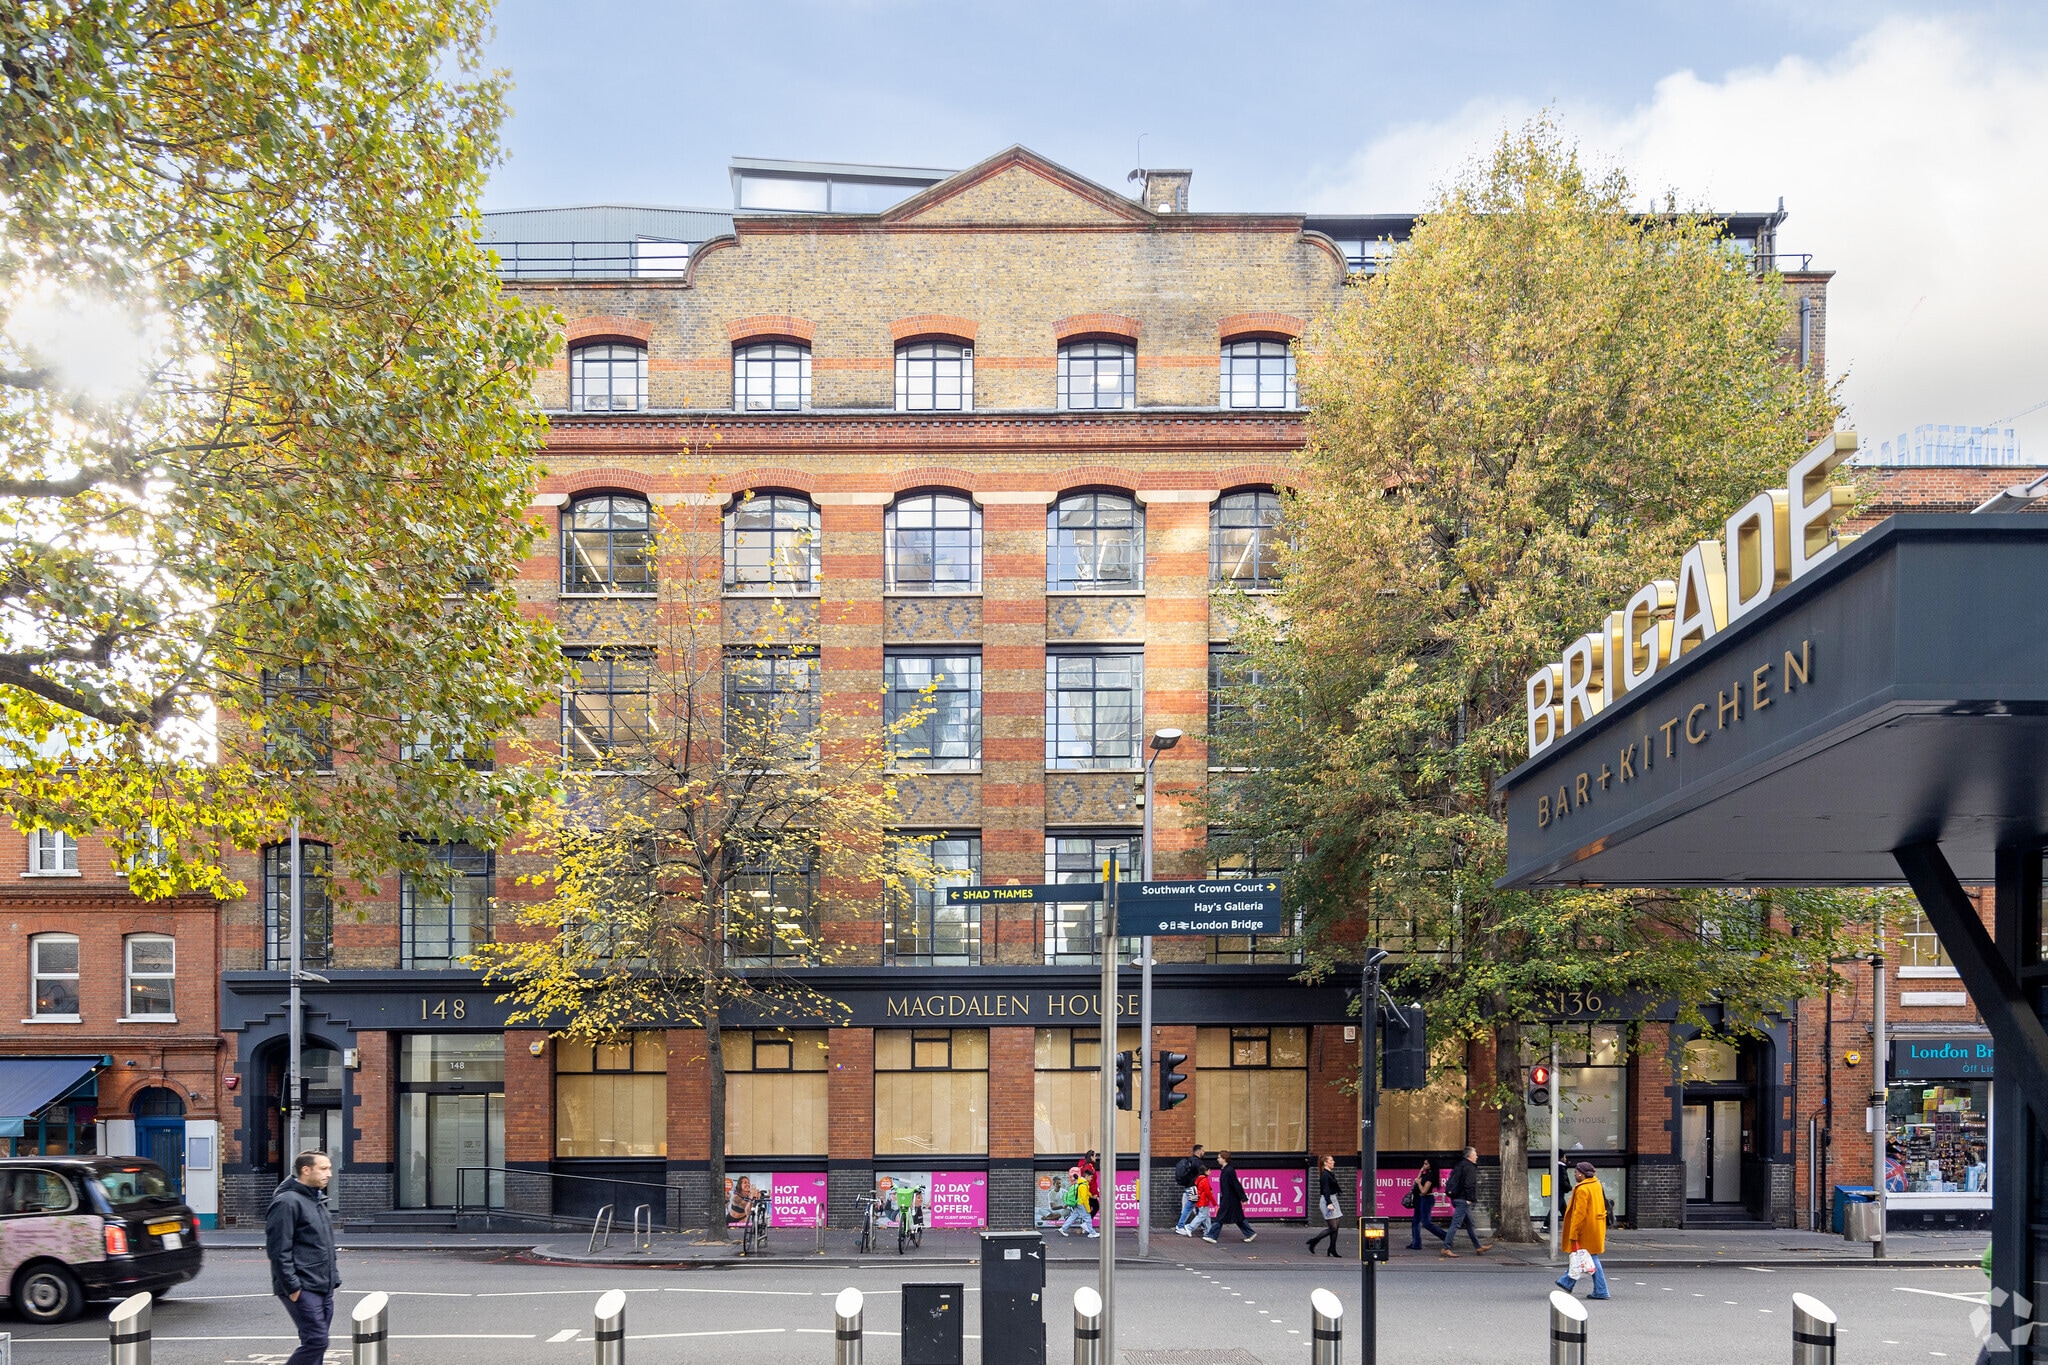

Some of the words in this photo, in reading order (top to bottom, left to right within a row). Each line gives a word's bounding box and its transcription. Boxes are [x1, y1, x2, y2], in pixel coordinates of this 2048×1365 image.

[1526, 432, 1857, 759] BRIGADE
[1142, 884, 1195, 895] Southwark
[1198, 884, 1231, 893] Crown
[1233, 883, 1264, 893] Court
[963, 890, 991, 900] SHAD
[993, 889, 1033, 899] THAMES
[1194, 902, 1222, 913] Hay's
[1224, 901, 1264, 911] Galleria
[1190, 920, 1229, 930] London
[1231, 919, 1264, 930] Bridge
[886, 995, 1030, 1017] MAGDALEN
[1559, 989, 1602, 1016] 136
[421, 998, 466, 1020] 148
[1911, 1043, 1969, 1059] London
[450, 1062, 465, 1070] 148
[1962, 1064, 1977, 1073] Off
[1532, 1116, 1576, 1124] MAGALEN
[1578, 1116, 1607, 1124] HOUSE
[1396, 1177, 1412, 1187] THE
[774, 1185, 799, 1195] HOT
[934, 1184, 946, 1193] 20
[948, 1184, 971, 1193] DAY
[774, 1196, 817, 1205] BIKRAM
[934, 1194, 970, 1203] INTRO
[1245, 1192, 1282, 1205] YOGA!
[774, 1206, 807, 1215] YOGA
[933, 1204, 973, 1214] OFFER!
[1365, 1229, 1385, 1238] WAIT
